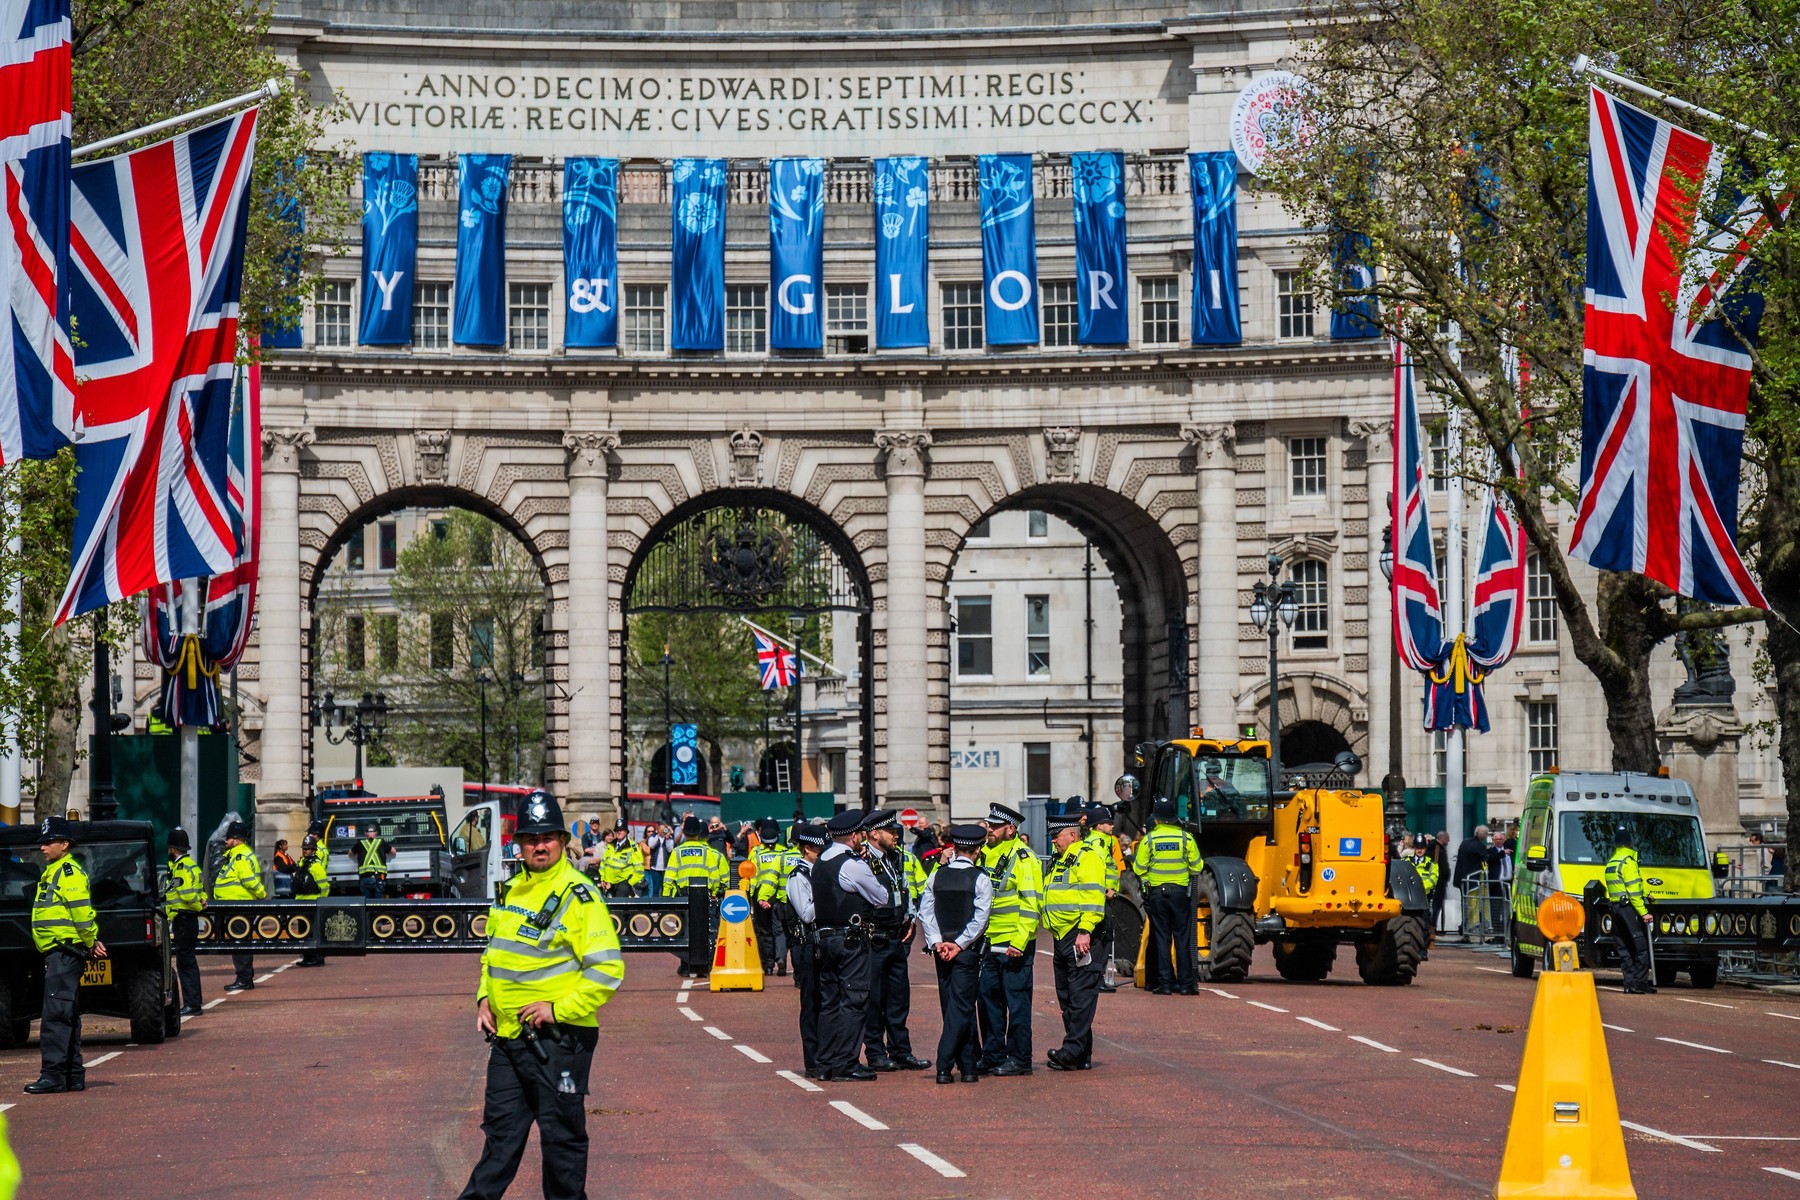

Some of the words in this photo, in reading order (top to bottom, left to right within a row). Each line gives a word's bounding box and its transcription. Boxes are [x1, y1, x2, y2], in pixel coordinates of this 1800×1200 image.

[1238, 85, 1259, 110] KING
[372, 270, 404, 311] Y
[569, 278, 611, 313] &
[84, 973, 105, 984] MUY
